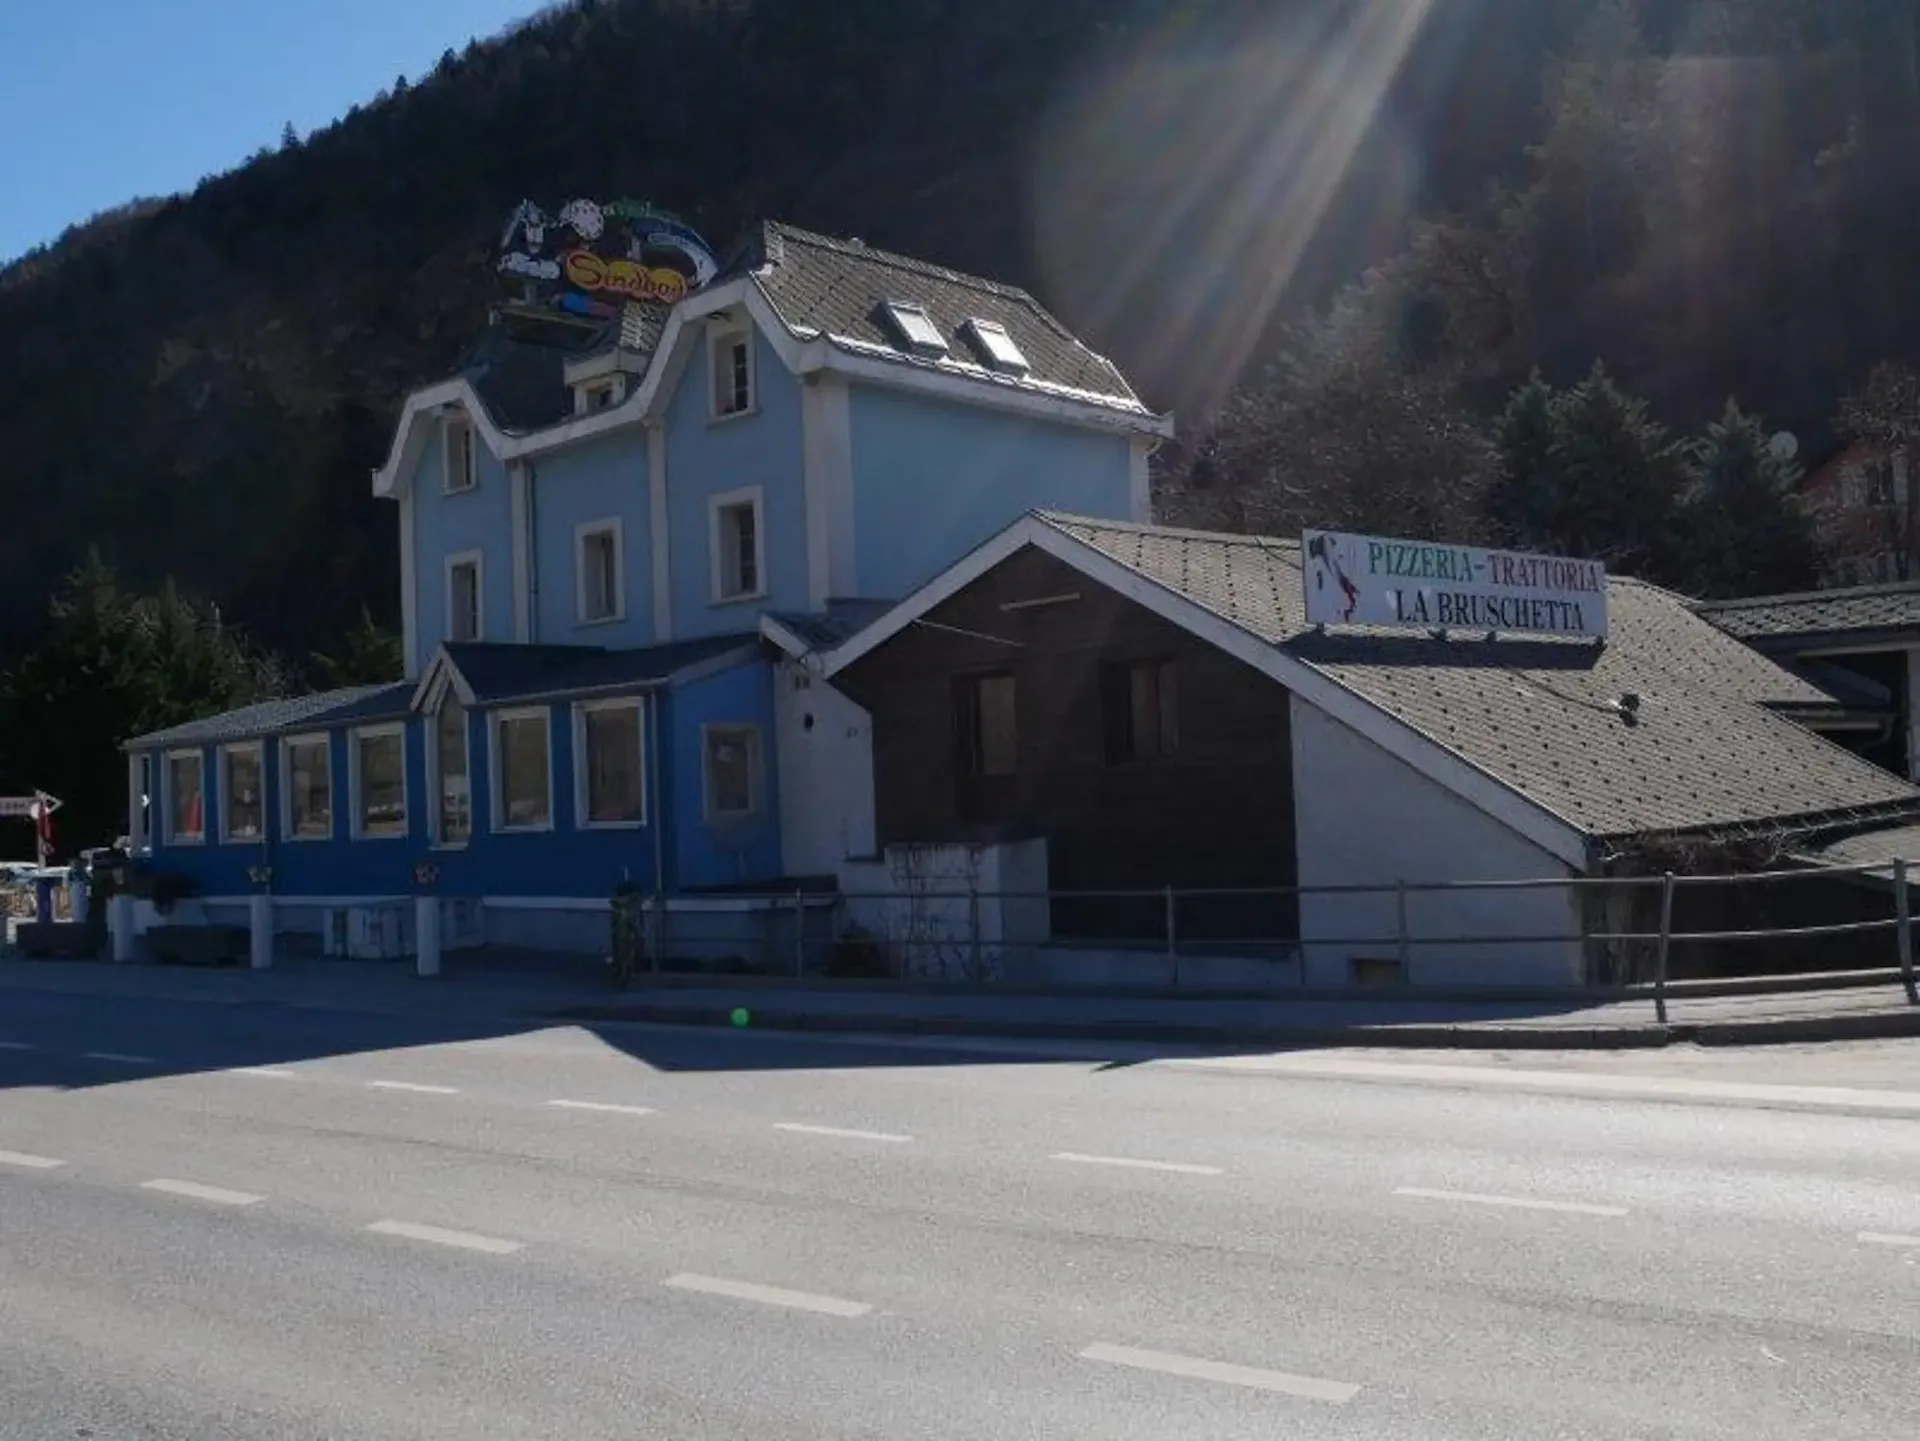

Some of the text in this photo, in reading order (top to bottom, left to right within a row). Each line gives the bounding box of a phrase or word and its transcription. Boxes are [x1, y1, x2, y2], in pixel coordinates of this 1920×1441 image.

[1368, 542, 1599, 592] PIZZERIA-TRATTORIA
[1396, 590, 1584, 630] LA BRUSCHETTA
